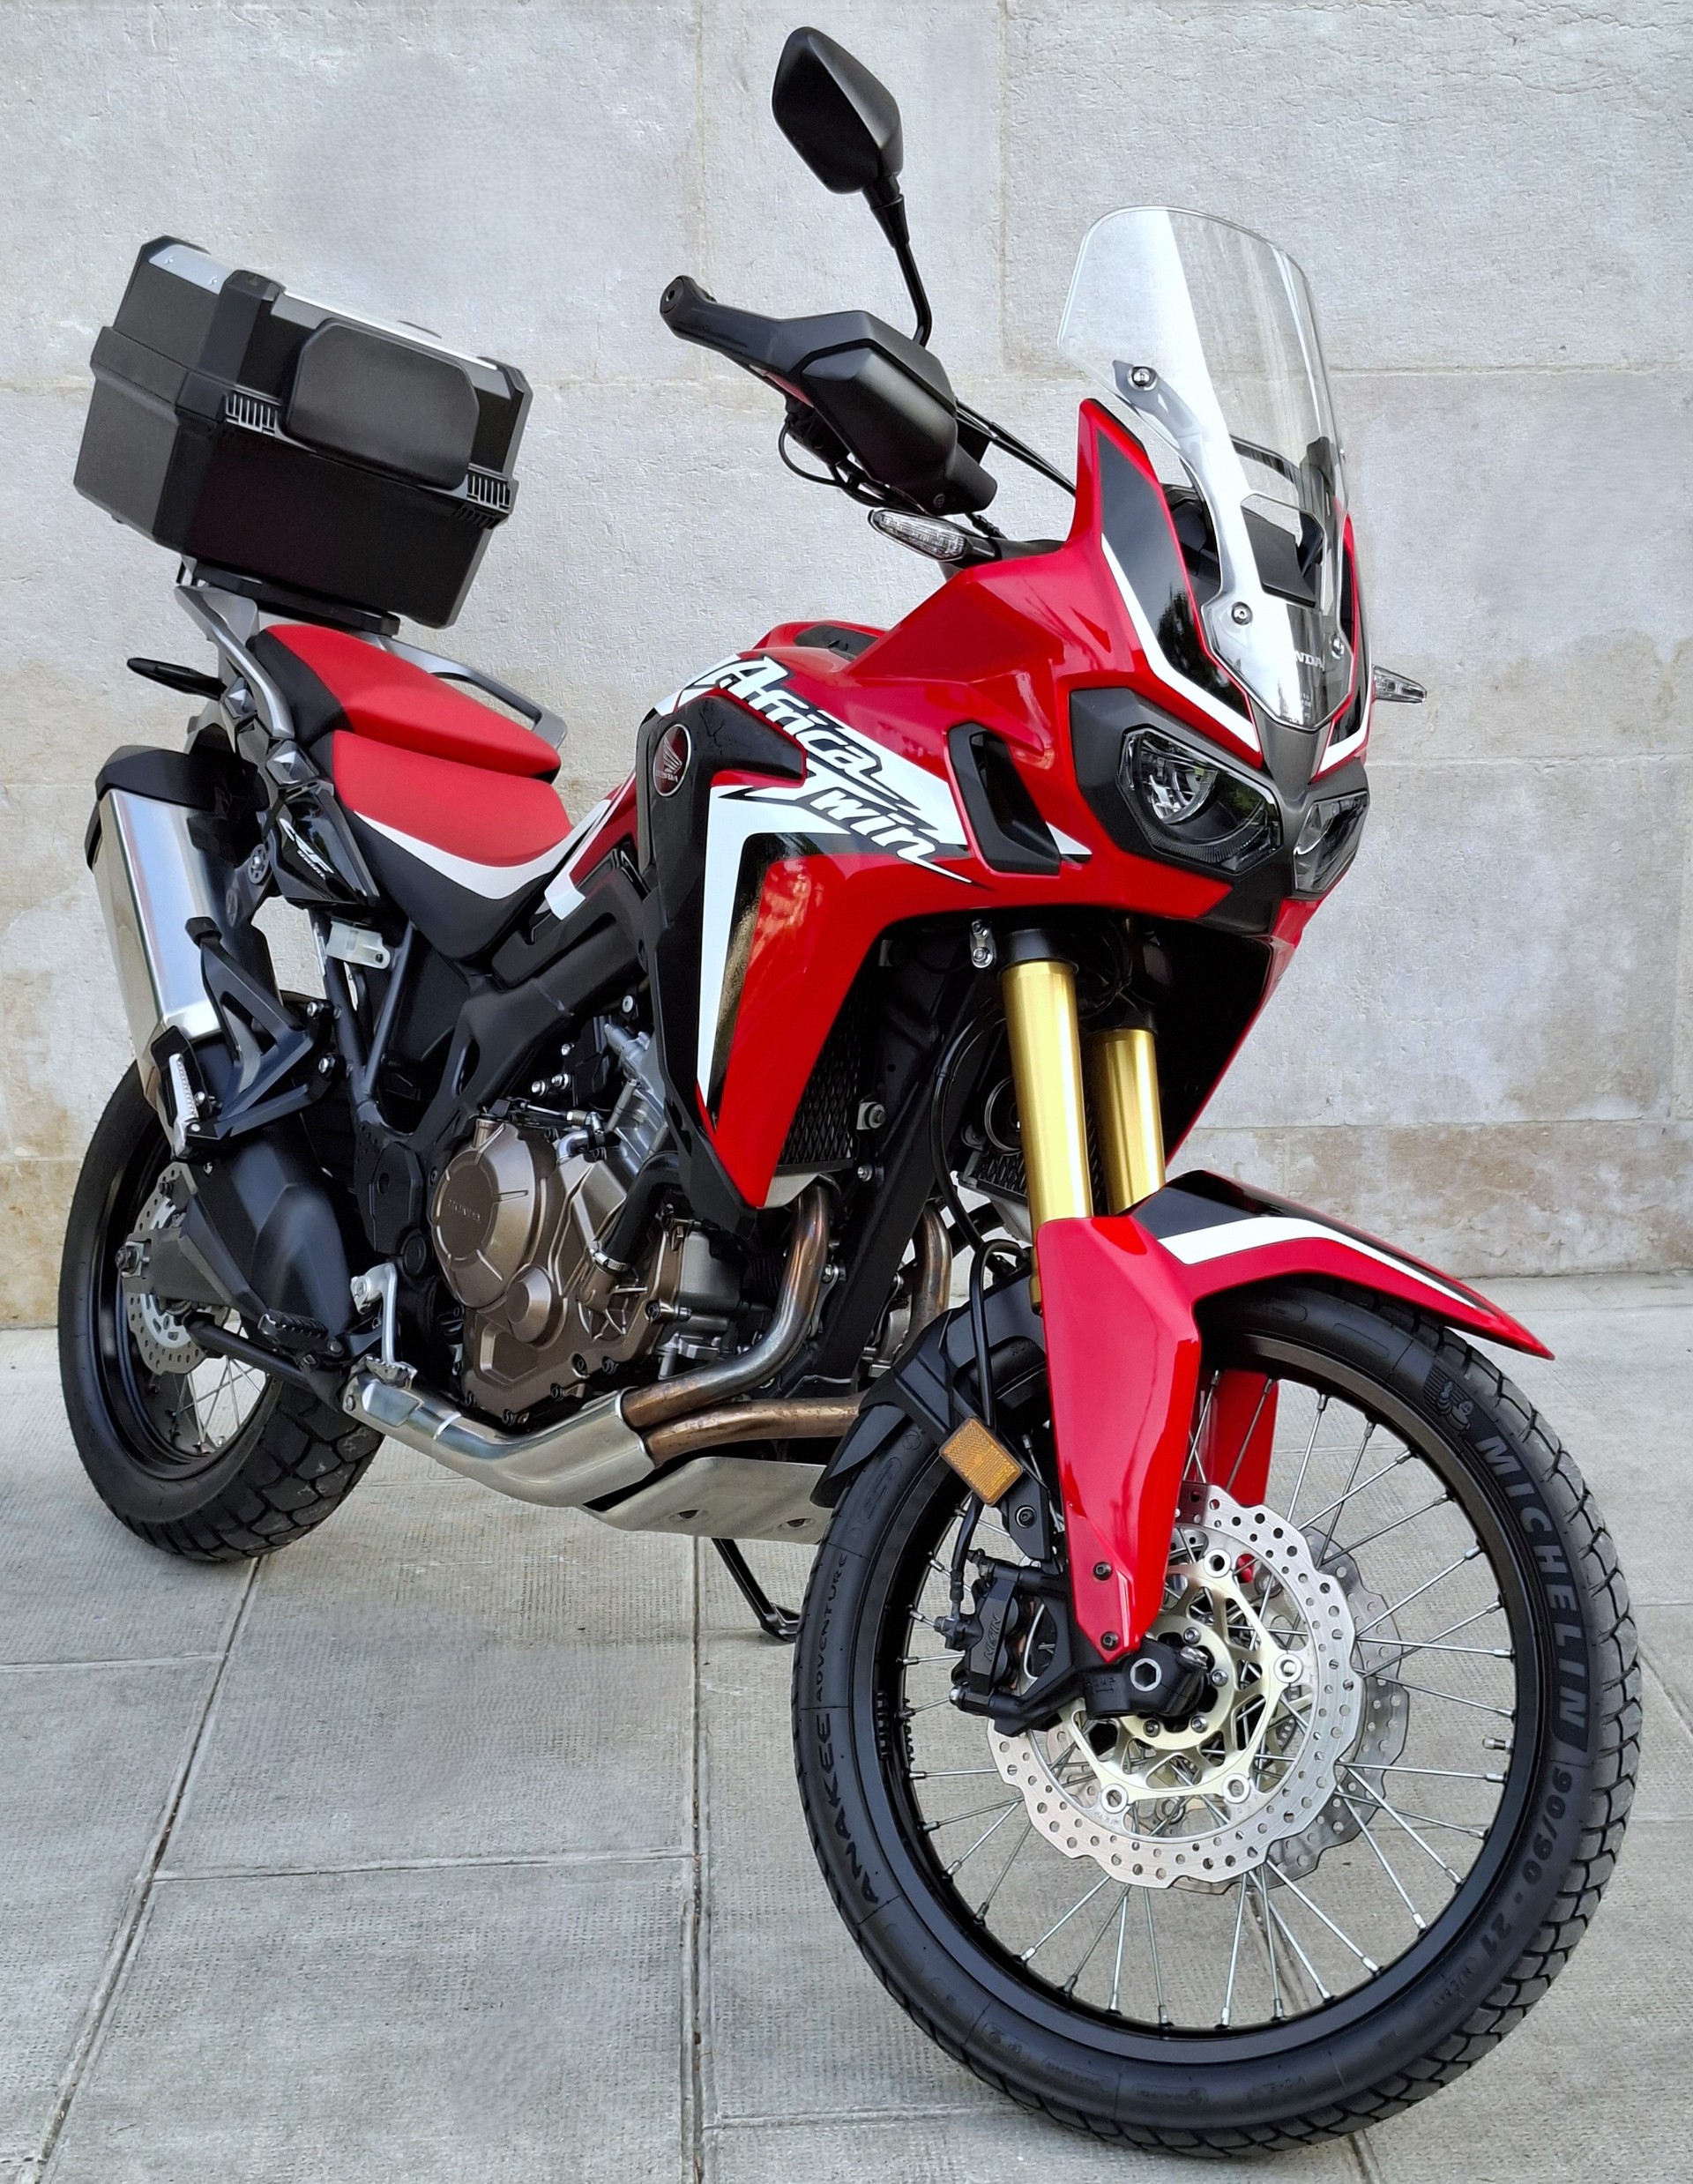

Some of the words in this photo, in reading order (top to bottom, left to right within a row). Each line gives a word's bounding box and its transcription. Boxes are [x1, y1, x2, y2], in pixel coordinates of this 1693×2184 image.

[712, 655, 899, 800] Africa
[1294, 651, 1324, 670] NDA
[745, 758, 972, 883] Twin
[816, 1553, 847, 1703] ADVENTURE
[1475, 1436, 1585, 1728] MICHELIN
[817, 1713, 879, 1904] ANAKEE
[1522, 1767, 1572, 1885] 90/90
[1480, 1912, 1512, 1957] 21
